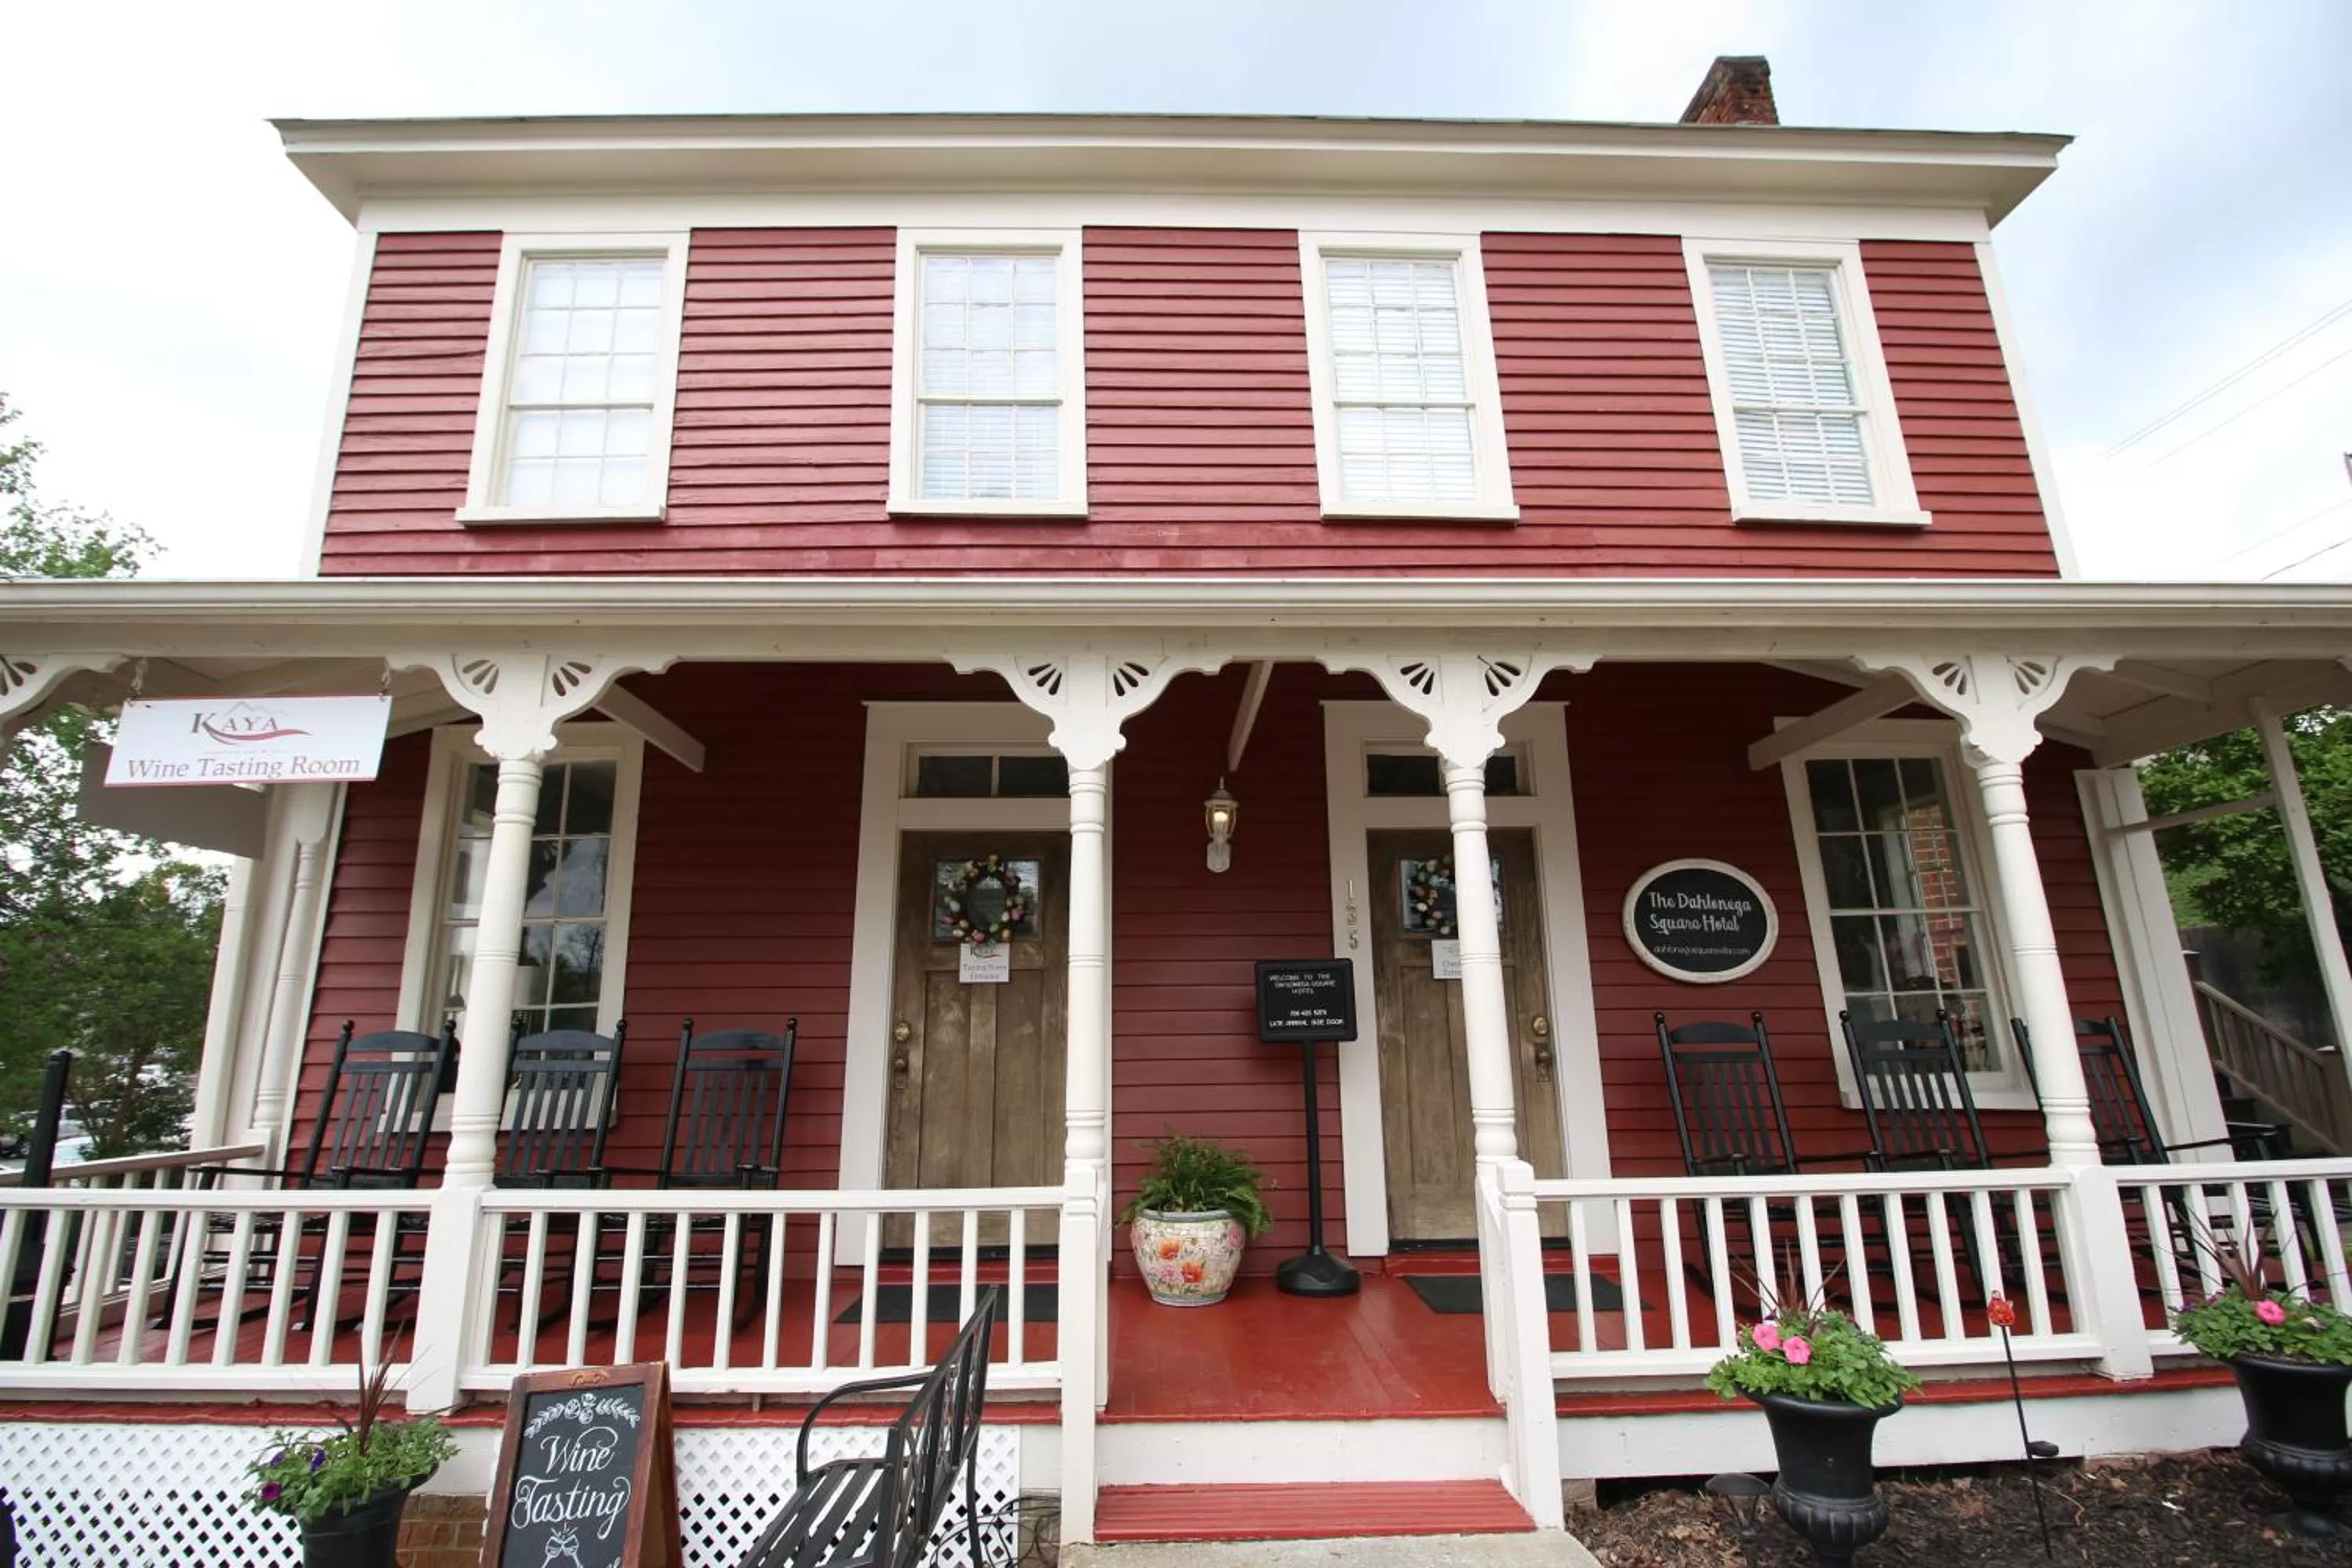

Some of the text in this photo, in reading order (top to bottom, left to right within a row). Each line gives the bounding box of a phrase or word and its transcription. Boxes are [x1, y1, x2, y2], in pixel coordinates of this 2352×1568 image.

[191, 712, 279, 734] KAYA
[128, 755, 361, 779] Wine Tasting Room
[1648, 891, 1675, 909] The
[1650, 913, 1740, 935] Square Hotel
[540, 1426, 619, 1474] Wine
[511, 1475, 631, 1540] Tasting
